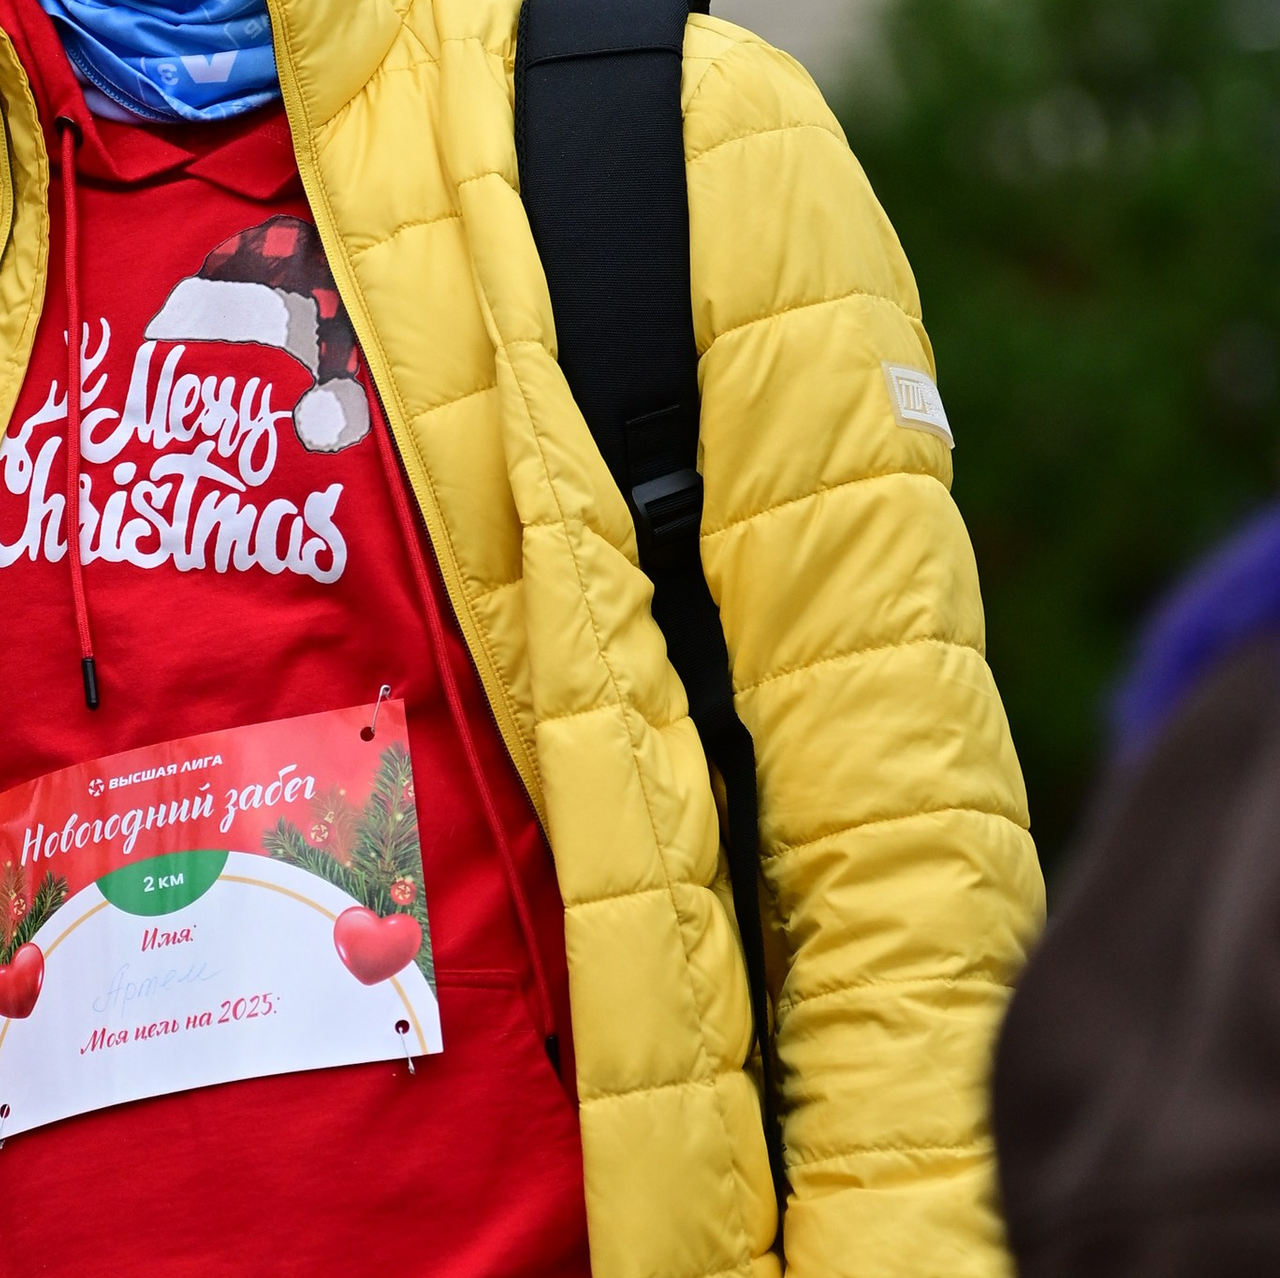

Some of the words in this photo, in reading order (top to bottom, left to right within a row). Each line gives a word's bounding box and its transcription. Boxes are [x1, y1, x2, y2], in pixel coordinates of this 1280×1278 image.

[79, 339, 293, 487] Merry
[108, 764, 177, 790] ВЫСШАЯ
[181, 754, 223, 772] ЛИГА
[20, 783, 215, 866] Новогодний
[220, 763, 316, 833] забег
[143, 876, 156, 892] 2
[158, 873, 185, 889] км
[141, 925, 197, 952] Имя:
[80, 1027, 129, 1055] Моя
[134, 1019, 180, 1040] цель
[185, 1011, 213, 1030] на
[218, 993, 280, 1024] 2025:
